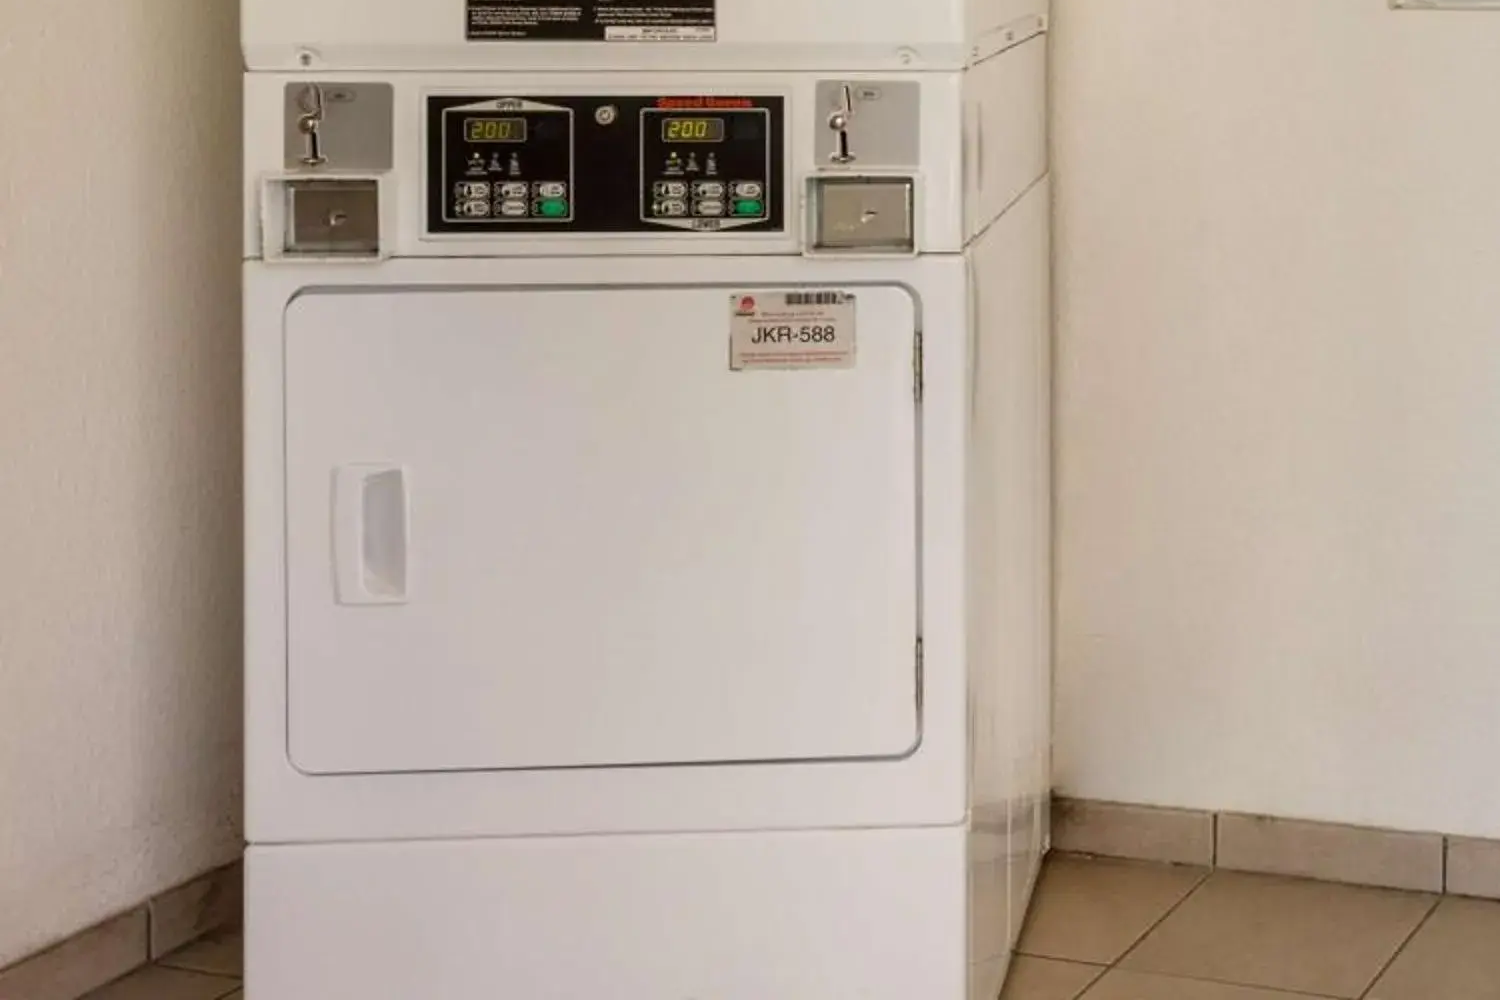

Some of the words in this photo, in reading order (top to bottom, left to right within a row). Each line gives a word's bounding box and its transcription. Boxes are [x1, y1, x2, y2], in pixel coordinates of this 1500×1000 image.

[470, 122, 510, 139] 200
[668, 121, 707, 138] 200
[751, 325, 836, 344] JKR-588
